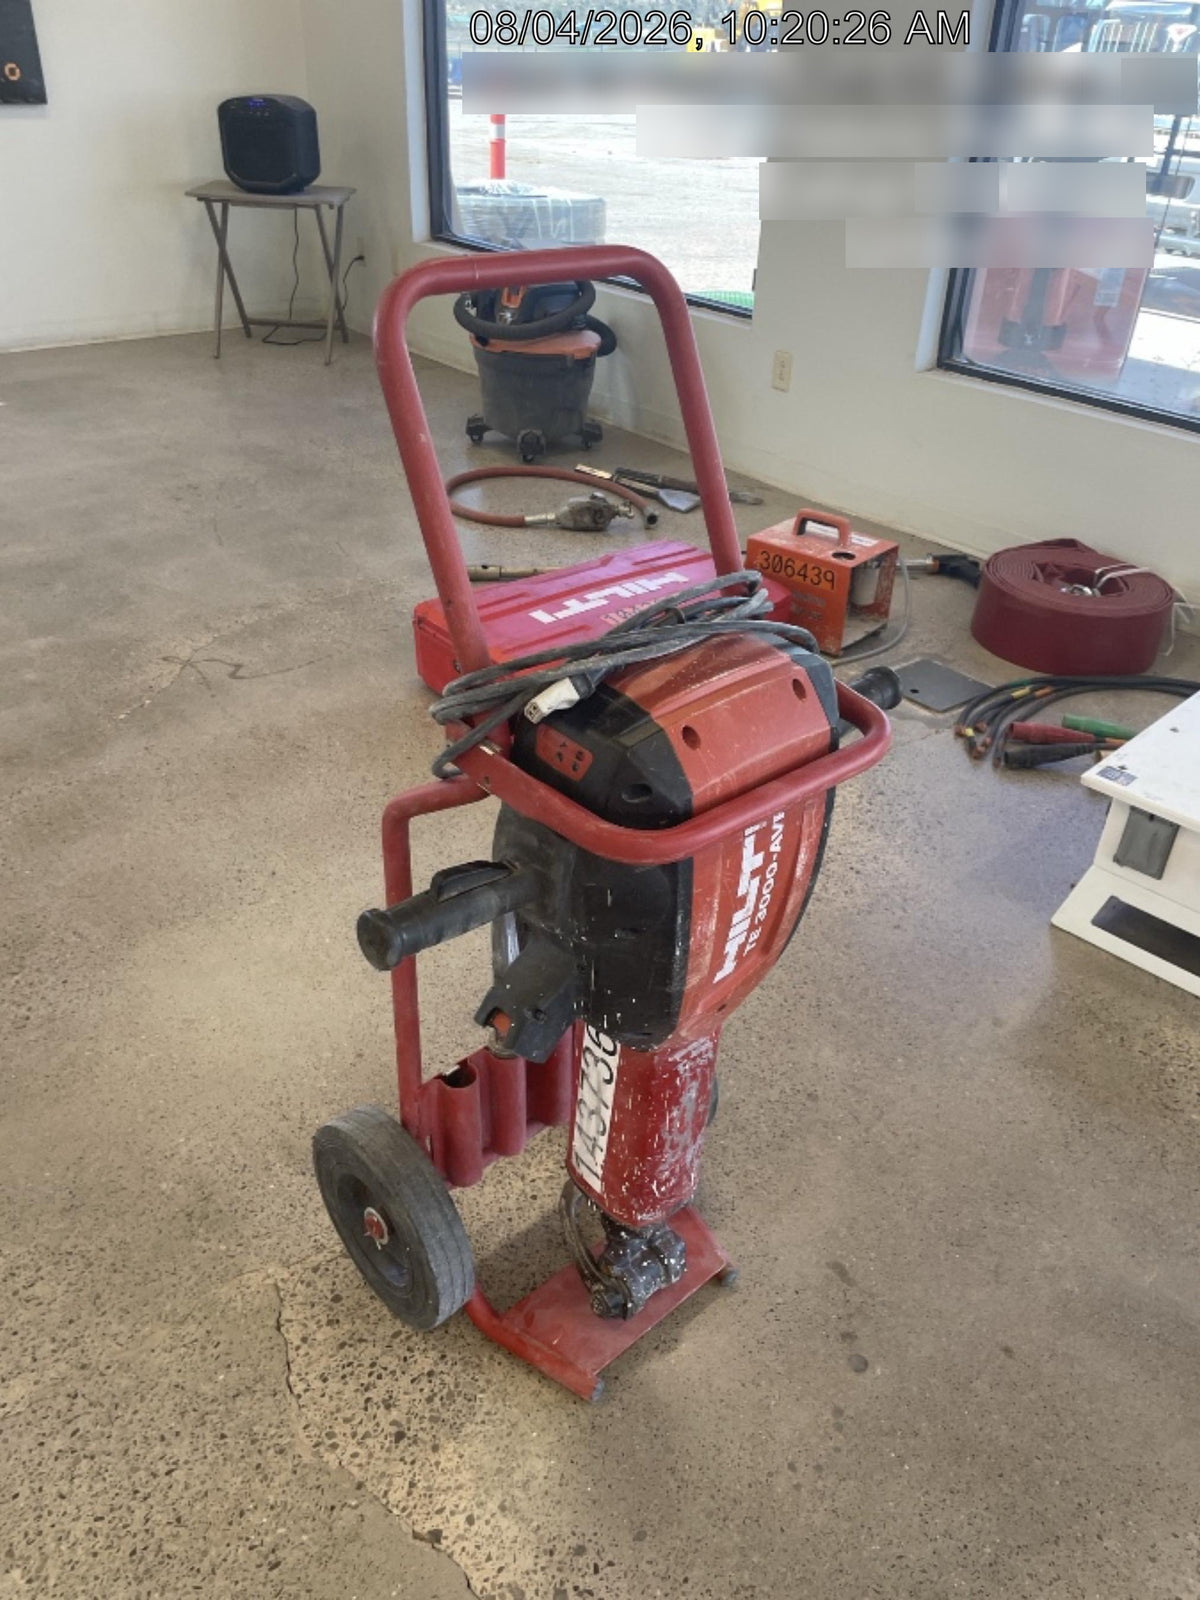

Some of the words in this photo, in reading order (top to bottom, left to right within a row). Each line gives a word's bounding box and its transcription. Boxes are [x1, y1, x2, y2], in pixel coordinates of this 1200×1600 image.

[759, 549, 836, 591] 306439
[528, 571, 689, 625] HILTI
[712, 820, 767, 984] HILTI
